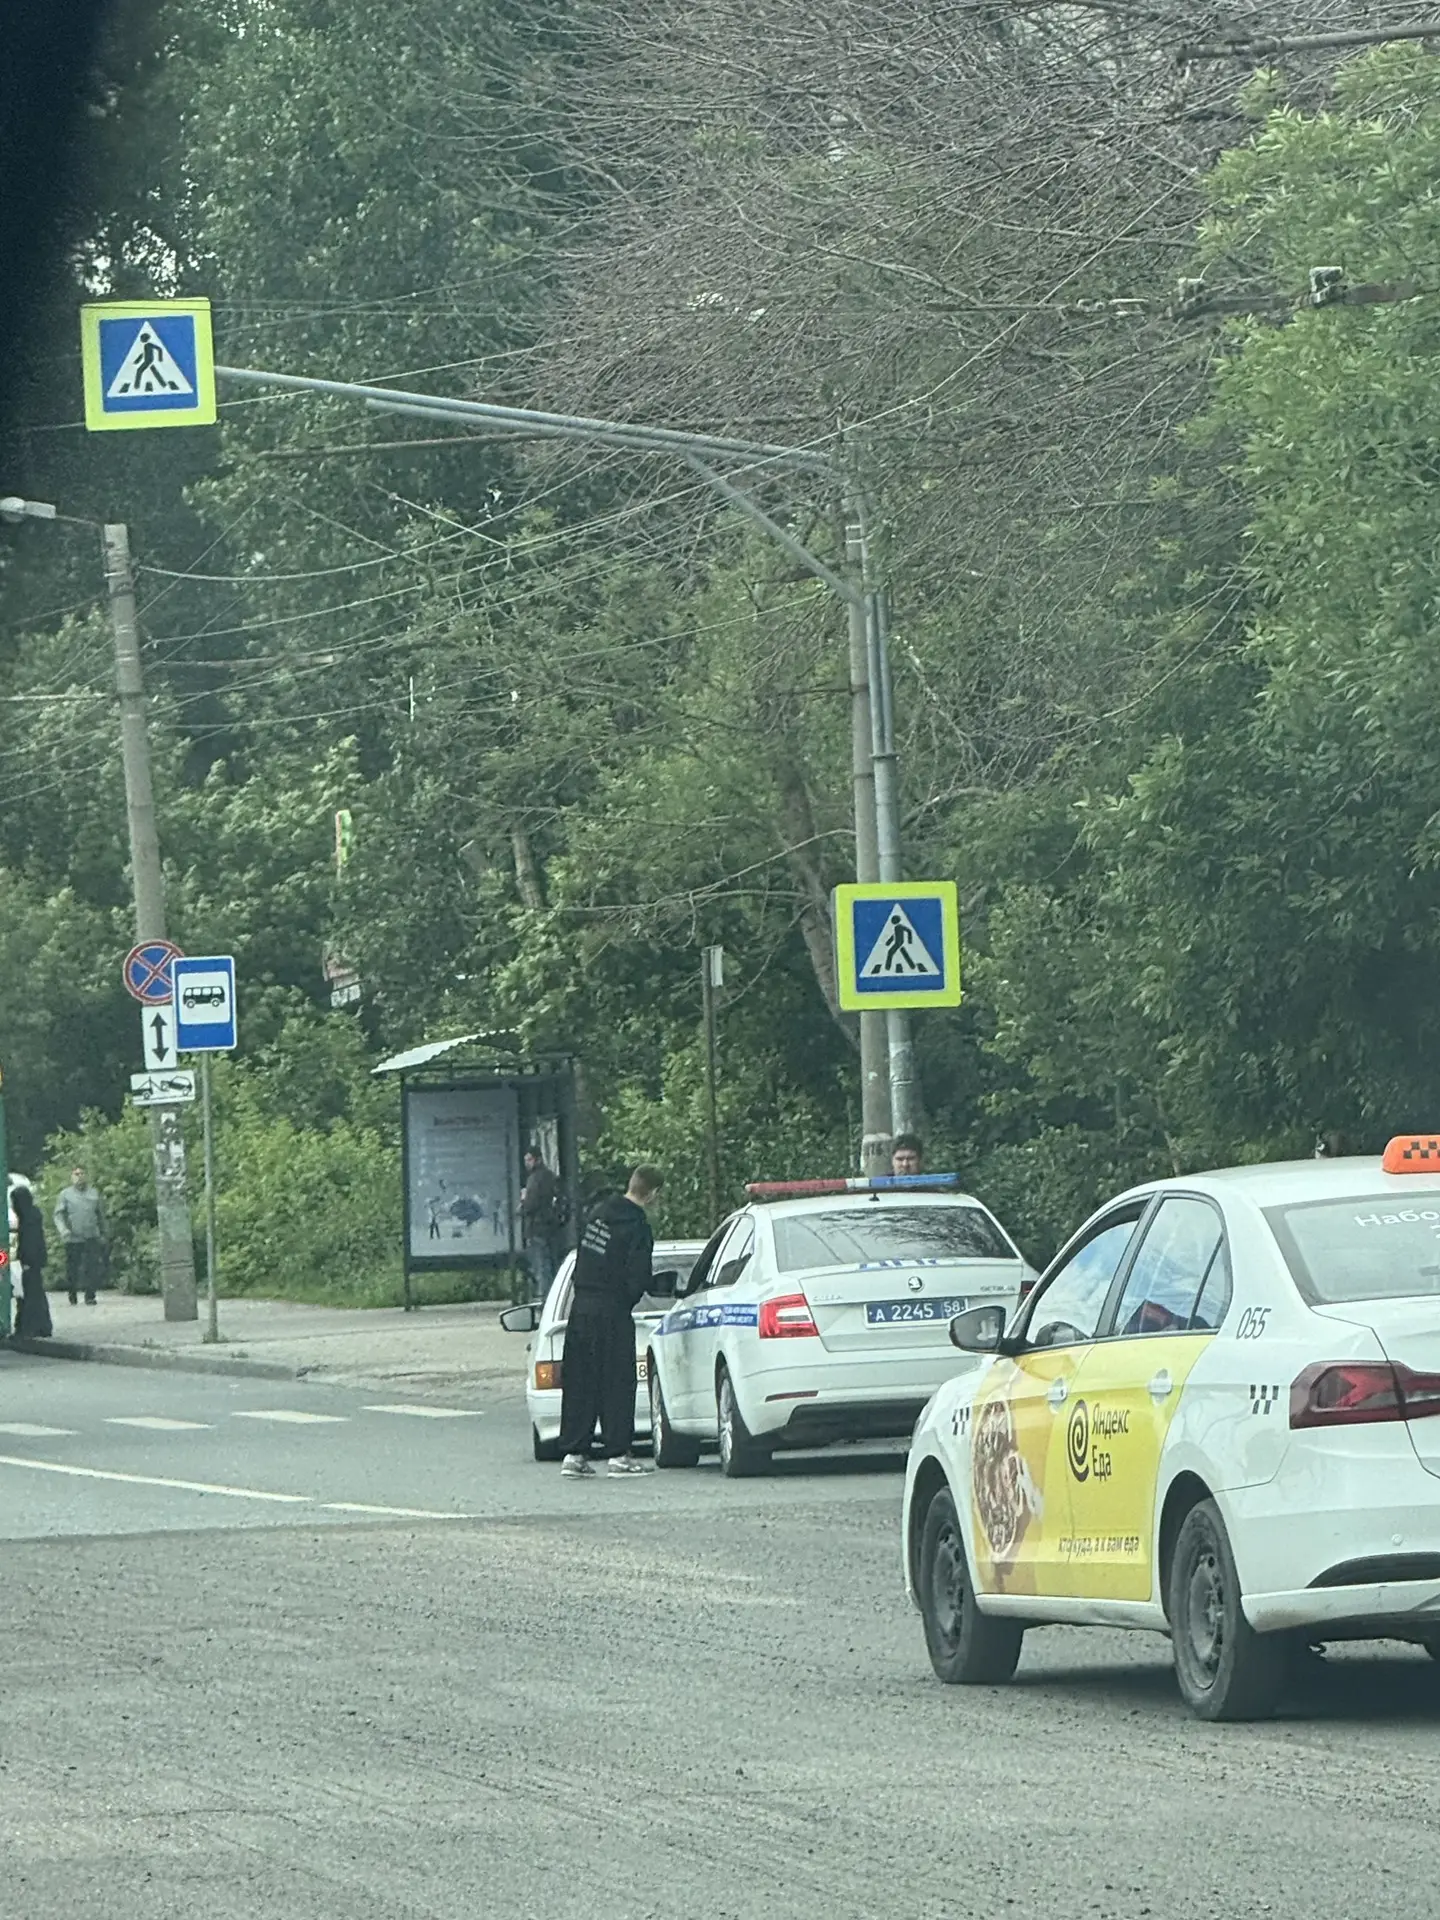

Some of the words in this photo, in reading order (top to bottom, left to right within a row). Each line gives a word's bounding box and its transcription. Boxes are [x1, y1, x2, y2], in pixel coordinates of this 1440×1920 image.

[1354, 1209, 1440, 1227] Набо
[891, 1303, 934, 1320] 2245
[943, 1300, 960, 1313] 58
[1235, 1306, 1272, 1340] 055
[1091, 1402, 1131, 1440] Яндекс
[1092, 1445, 1112, 1481] Еда
[1124, 1536, 1139, 1555] еда
